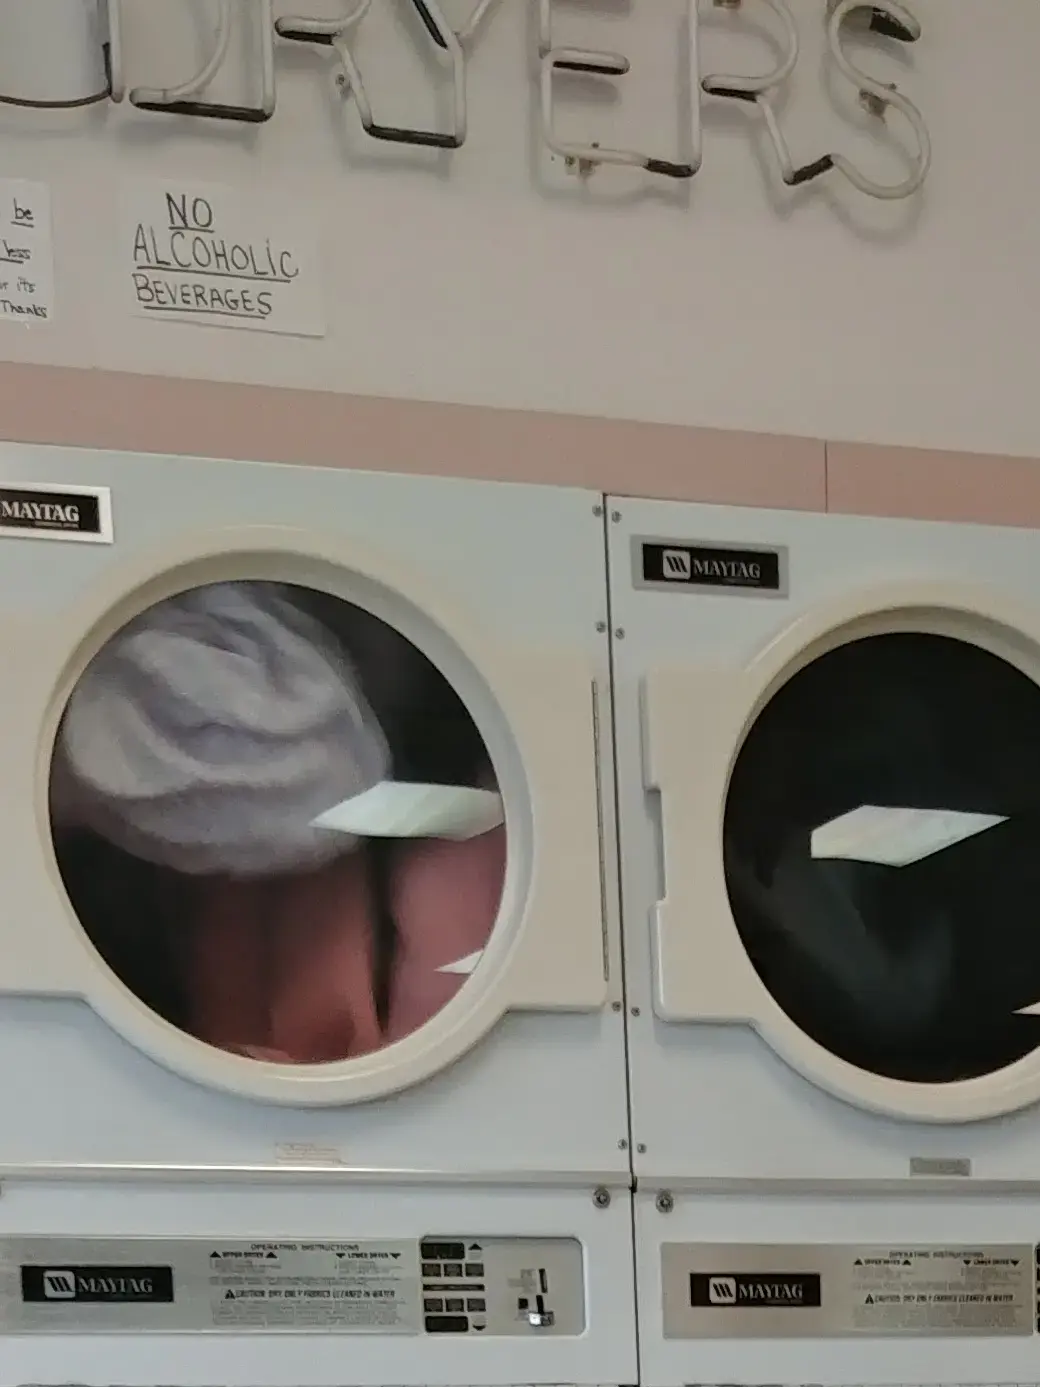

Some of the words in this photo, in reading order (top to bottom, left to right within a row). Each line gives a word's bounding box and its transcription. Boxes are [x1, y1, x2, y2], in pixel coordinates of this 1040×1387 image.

[13, 197, 34, 219] be
[165, 192, 213, 228] NO
[132, 273, 272, 316] BEVERAGES
[2, 501, 79, 521] MAYTAG
[694, 559, 760, 578] MAYTAG
[78, 1277, 153, 1293] MAYTAG
[740, 1284, 803, 1299] MAYTAG
